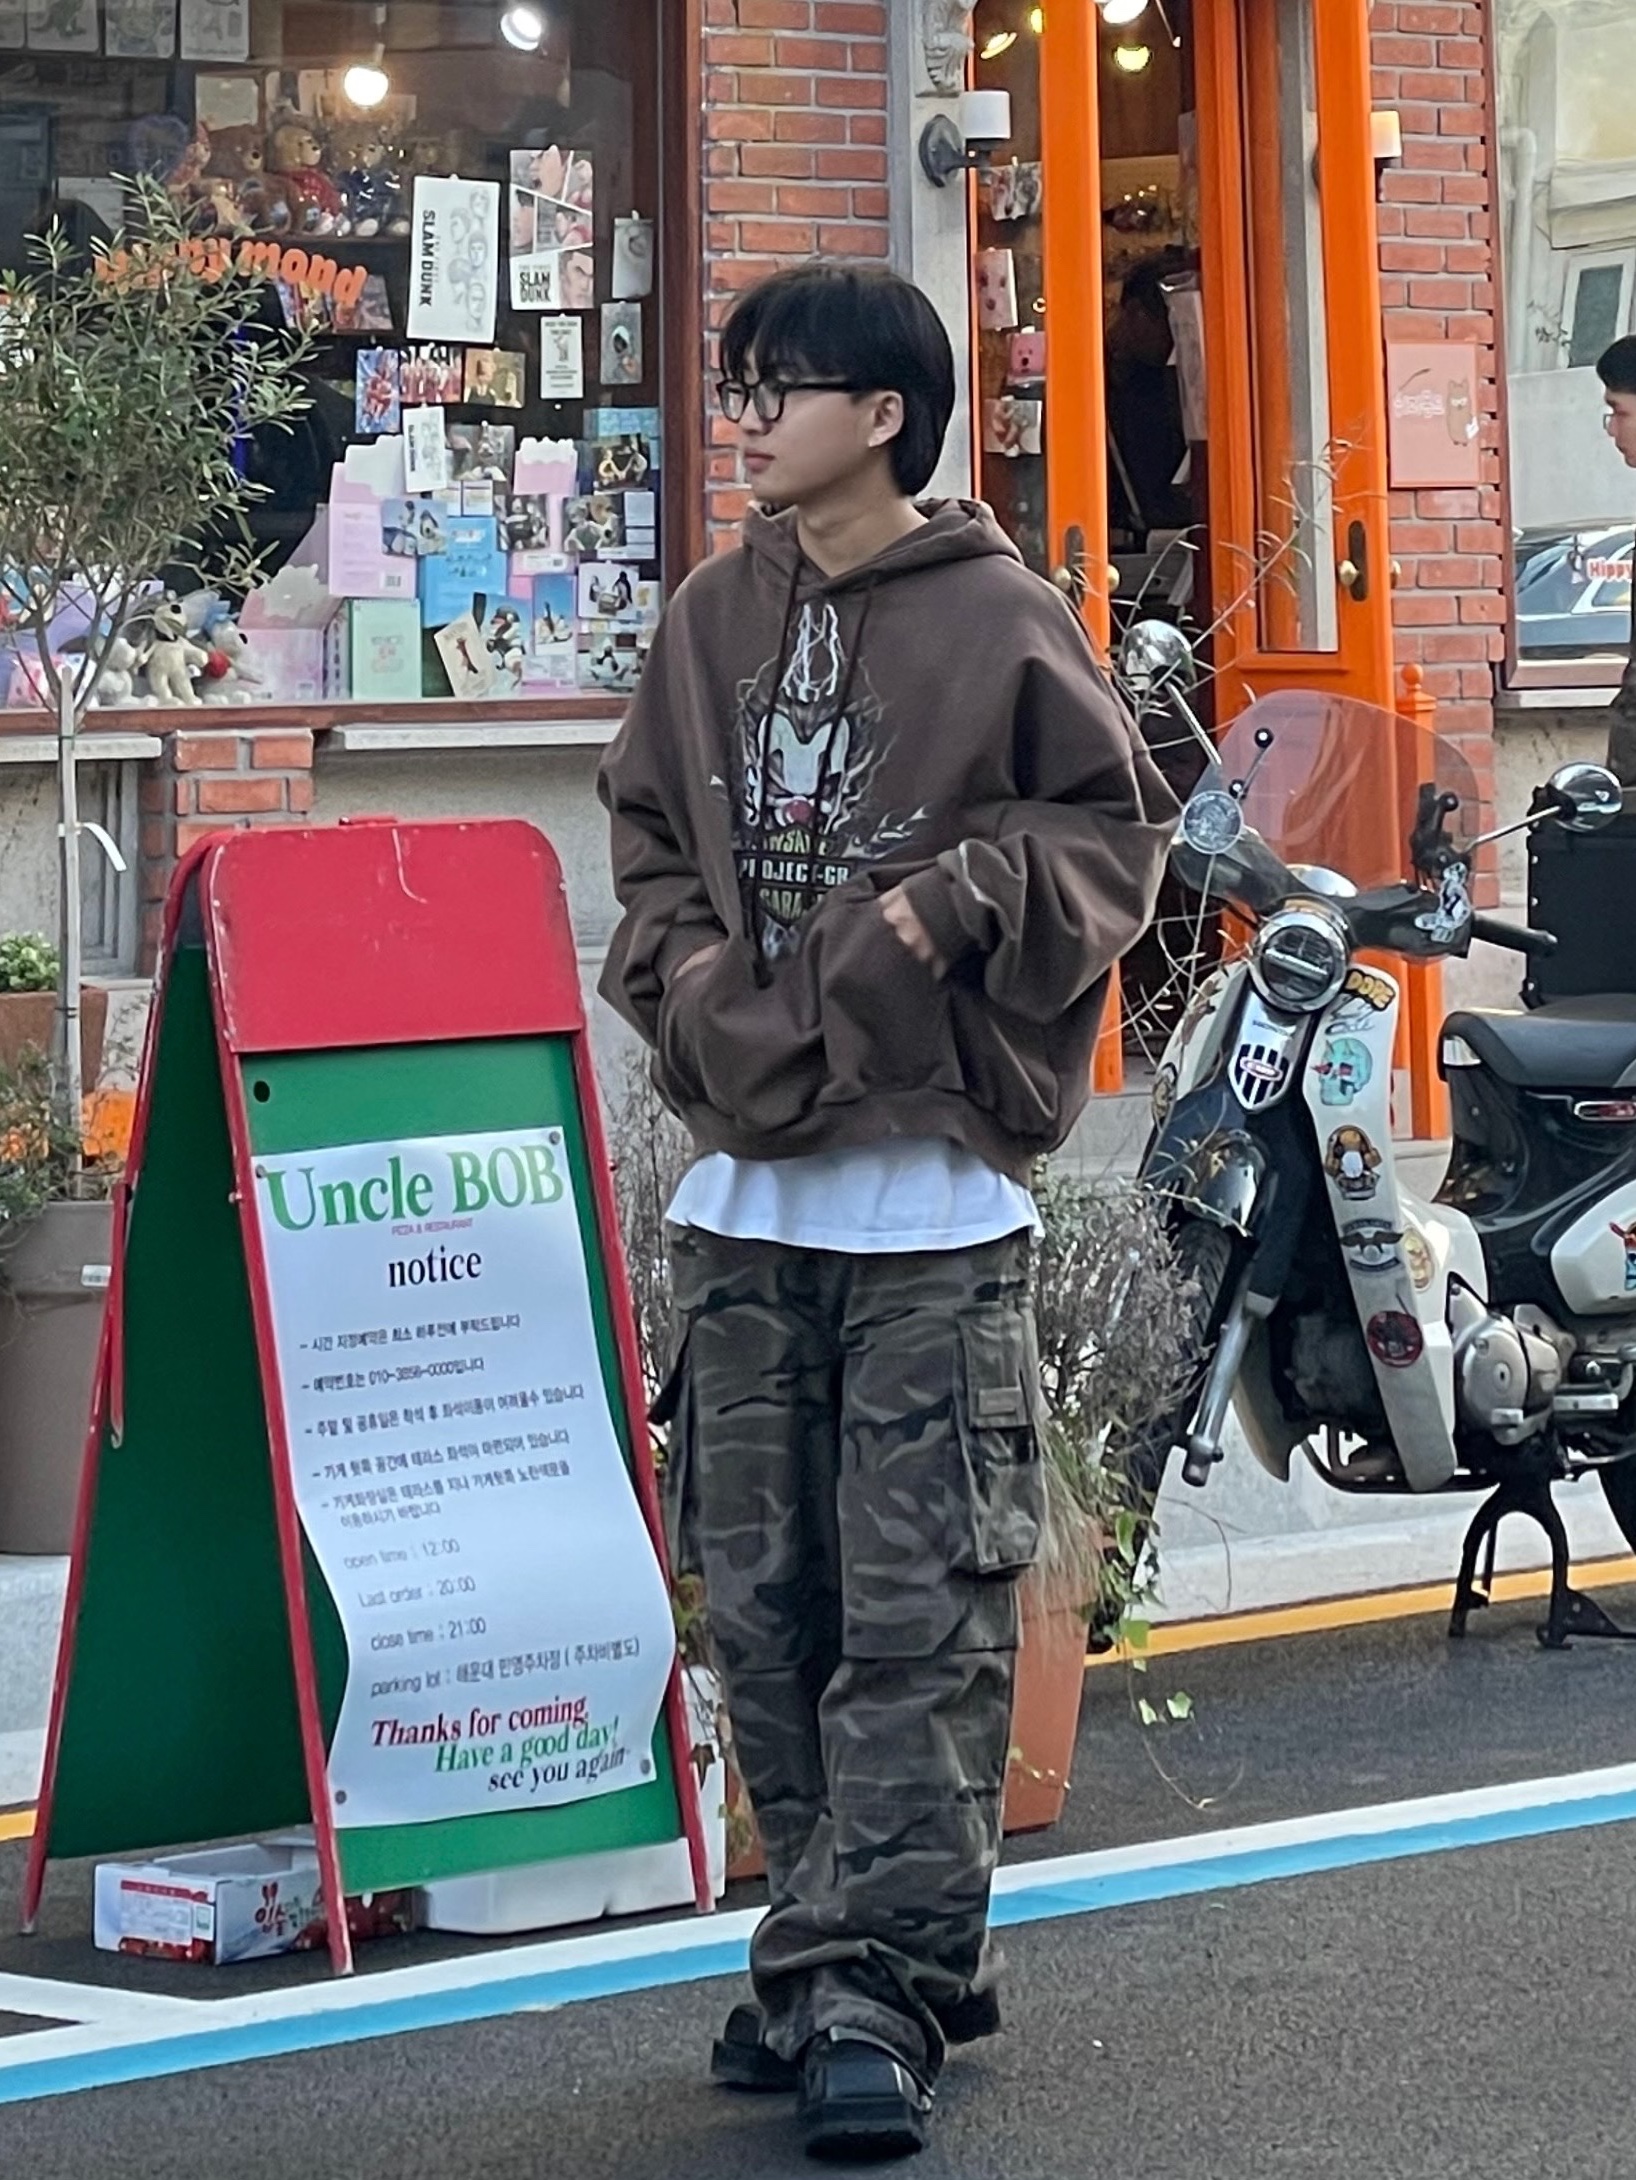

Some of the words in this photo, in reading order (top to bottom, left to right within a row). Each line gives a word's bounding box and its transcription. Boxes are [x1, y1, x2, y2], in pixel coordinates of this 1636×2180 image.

[422, 210, 436, 257] SLAM
[419, 260, 434, 307] DUNK
[519, 271, 550, 287] SLAM
[520, 284, 551, 303] DUNK
[1345, 970, 1394, 1009] DOPE
[264, 1155, 433, 1231] Uncle
[447, 1145, 564, 1213] BOB
[388, 1245, 482, 1288] notice
[422, 1538, 460, 1557] 12:00
[437, 1575, 476, 1596] 20:00
[448, 1616, 487, 1639] 21:00
[371, 1713, 462, 1747] Thanks
[468, 1707, 502, 1738] for
[434, 1743, 494, 1772] Have
[500, 1741, 514, 1763] a
[519, 1725, 571, 1768] good
[488, 1769, 525, 1792] see
[529, 1760, 569, 1792] you
